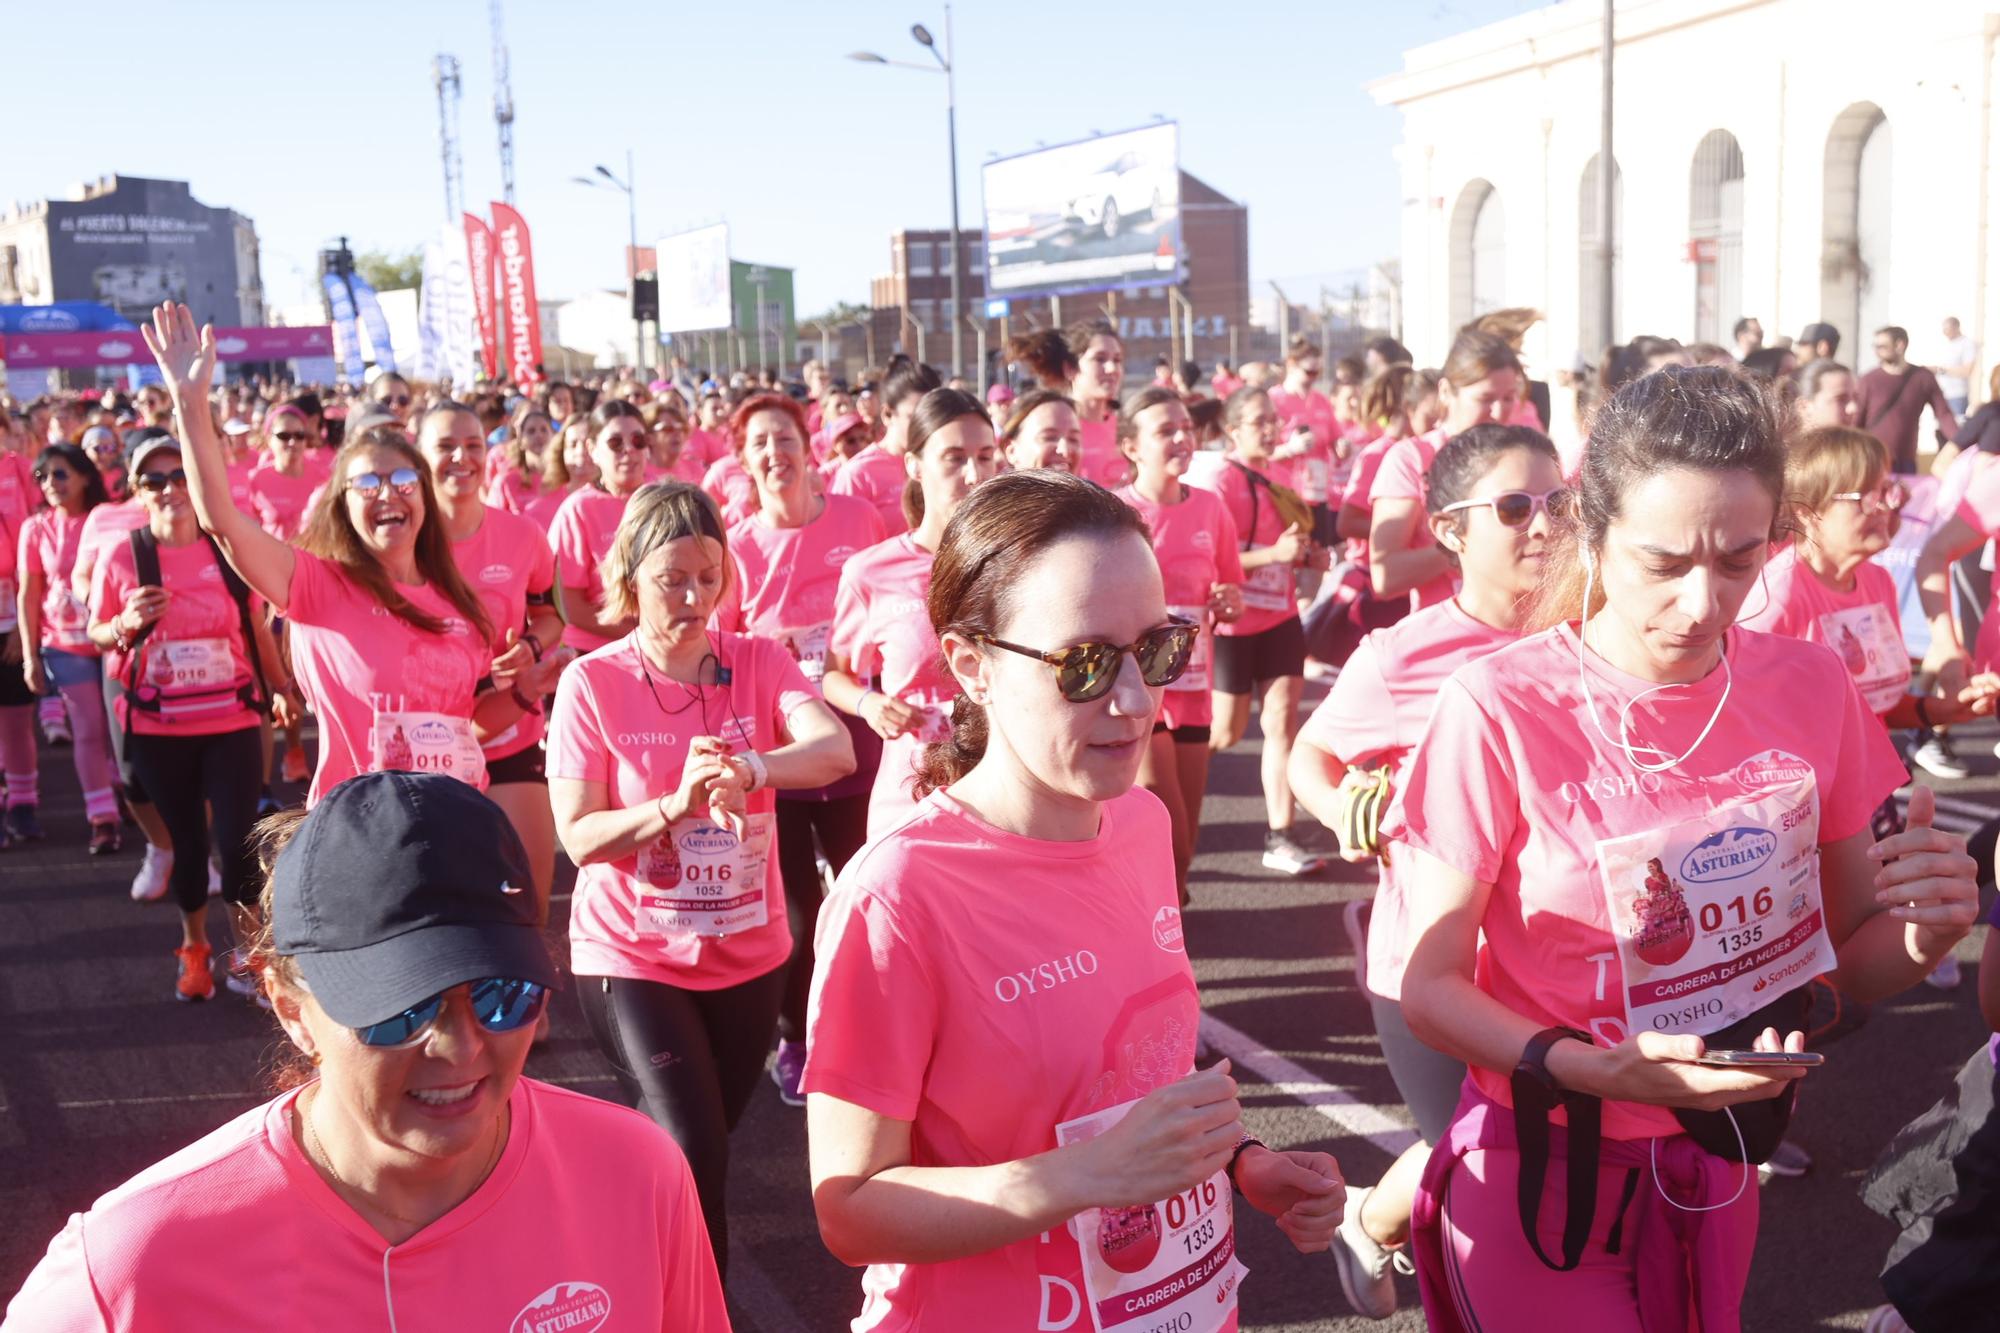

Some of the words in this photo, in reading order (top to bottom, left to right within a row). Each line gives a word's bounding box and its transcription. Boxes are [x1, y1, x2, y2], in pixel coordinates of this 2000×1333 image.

[618, 732, 676, 746] OYSHO
[417, 754, 453, 769] 016
[1561, 773, 1662, 803] OYSHO
[1783, 806, 1812, 832] SUMA
[685, 837, 734, 848] ASTURIANA
[686, 864, 732, 881] 016
[1689, 842, 1771, 878] ASTURIANA
[695, 885, 723, 896] 1052
[1699, 886, 1773, 932] 016
[1718, 925, 1762, 954] 1335
[1655, 970, 1717, 997] CARRERA
[1721, 965, 1737, 979] DE
[1738, 957, 1754, 970] LA
[1755, 939, 1791, 963] MUJER
[1792, 921, 1812, 943] 2023
[994, 950, 1098, 1002] OYSHO
[1652, 998, 1724, 1030] OYSHO
[1768, 947, 1817, 986] Santander
[1166, 1180, 1216, 1230] 016
[1183, 1218, 1215, 1255] 1333
[1125, 1278, 1186, 1312] CARRERA
[1187, 1267, 1203, 1286] DE
[1203, 1259, 1214, 1276] LA
[534, 1303, 570, 1320] CENTRAL
